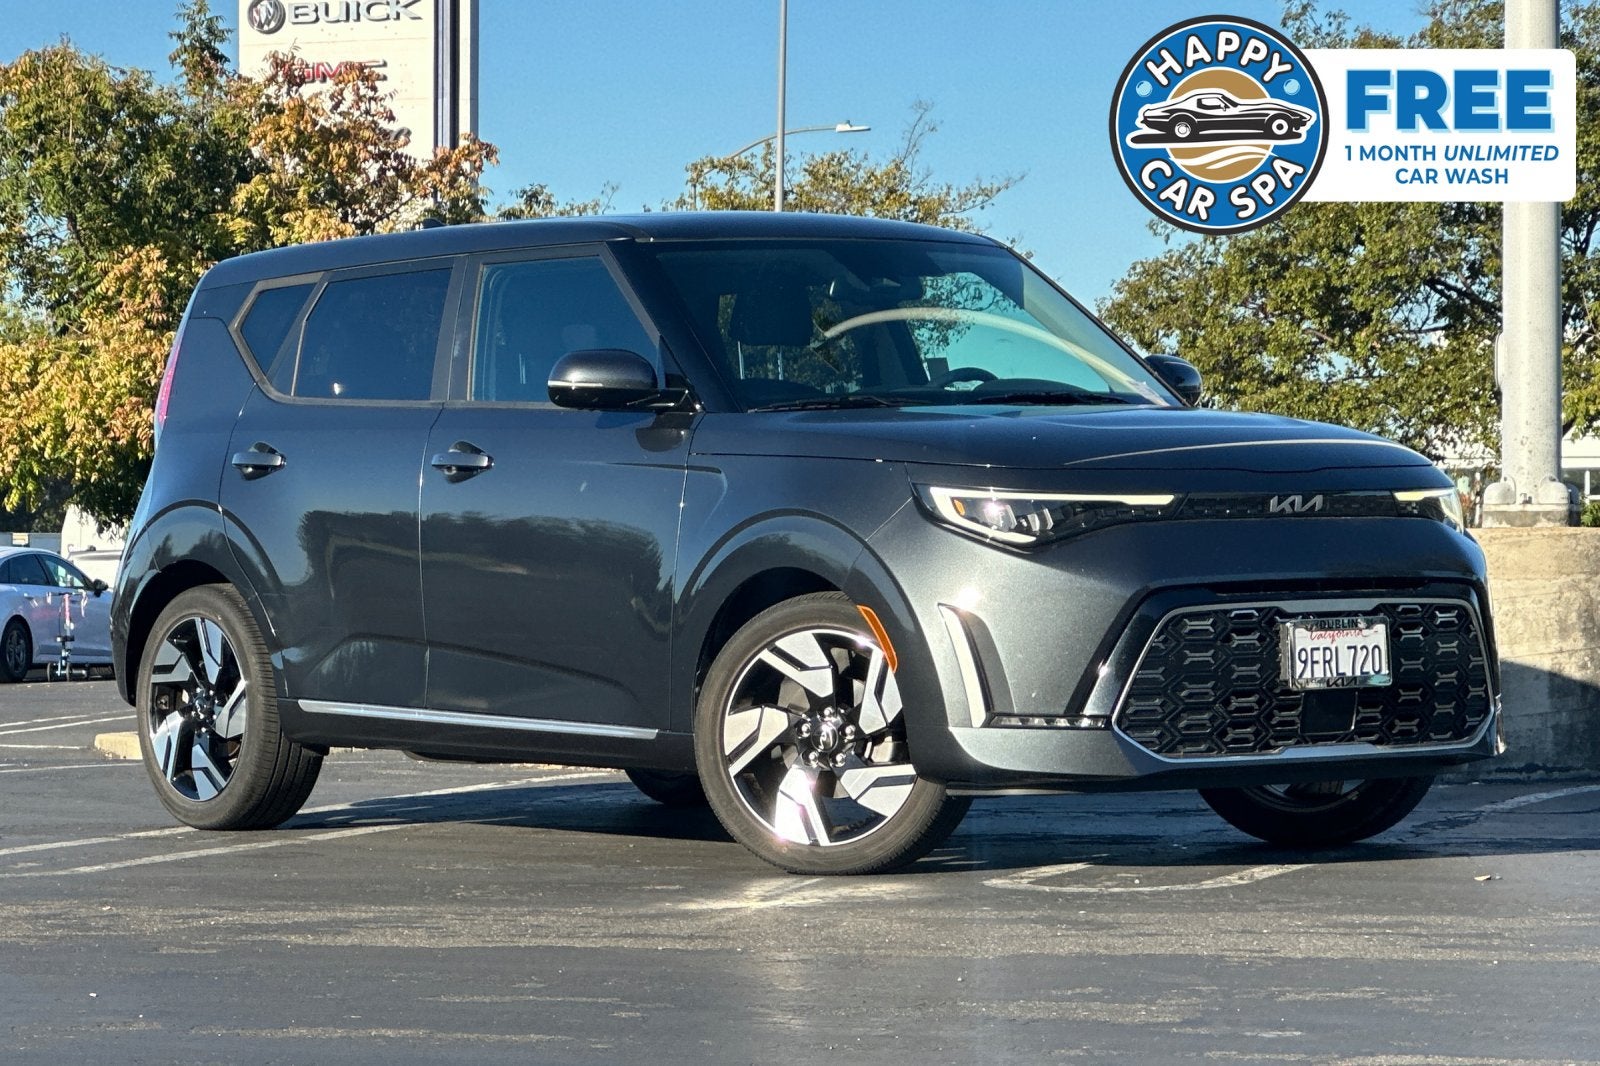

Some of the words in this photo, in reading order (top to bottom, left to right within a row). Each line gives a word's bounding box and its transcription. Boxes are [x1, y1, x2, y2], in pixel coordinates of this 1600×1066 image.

[288, 0, 423, 25] BUICK
[1269, 494, 1324, 514] KIA
[1319, 618, 1359, 630] DUBLIN
[1297, 644, 1382, 680] 9FRL720
